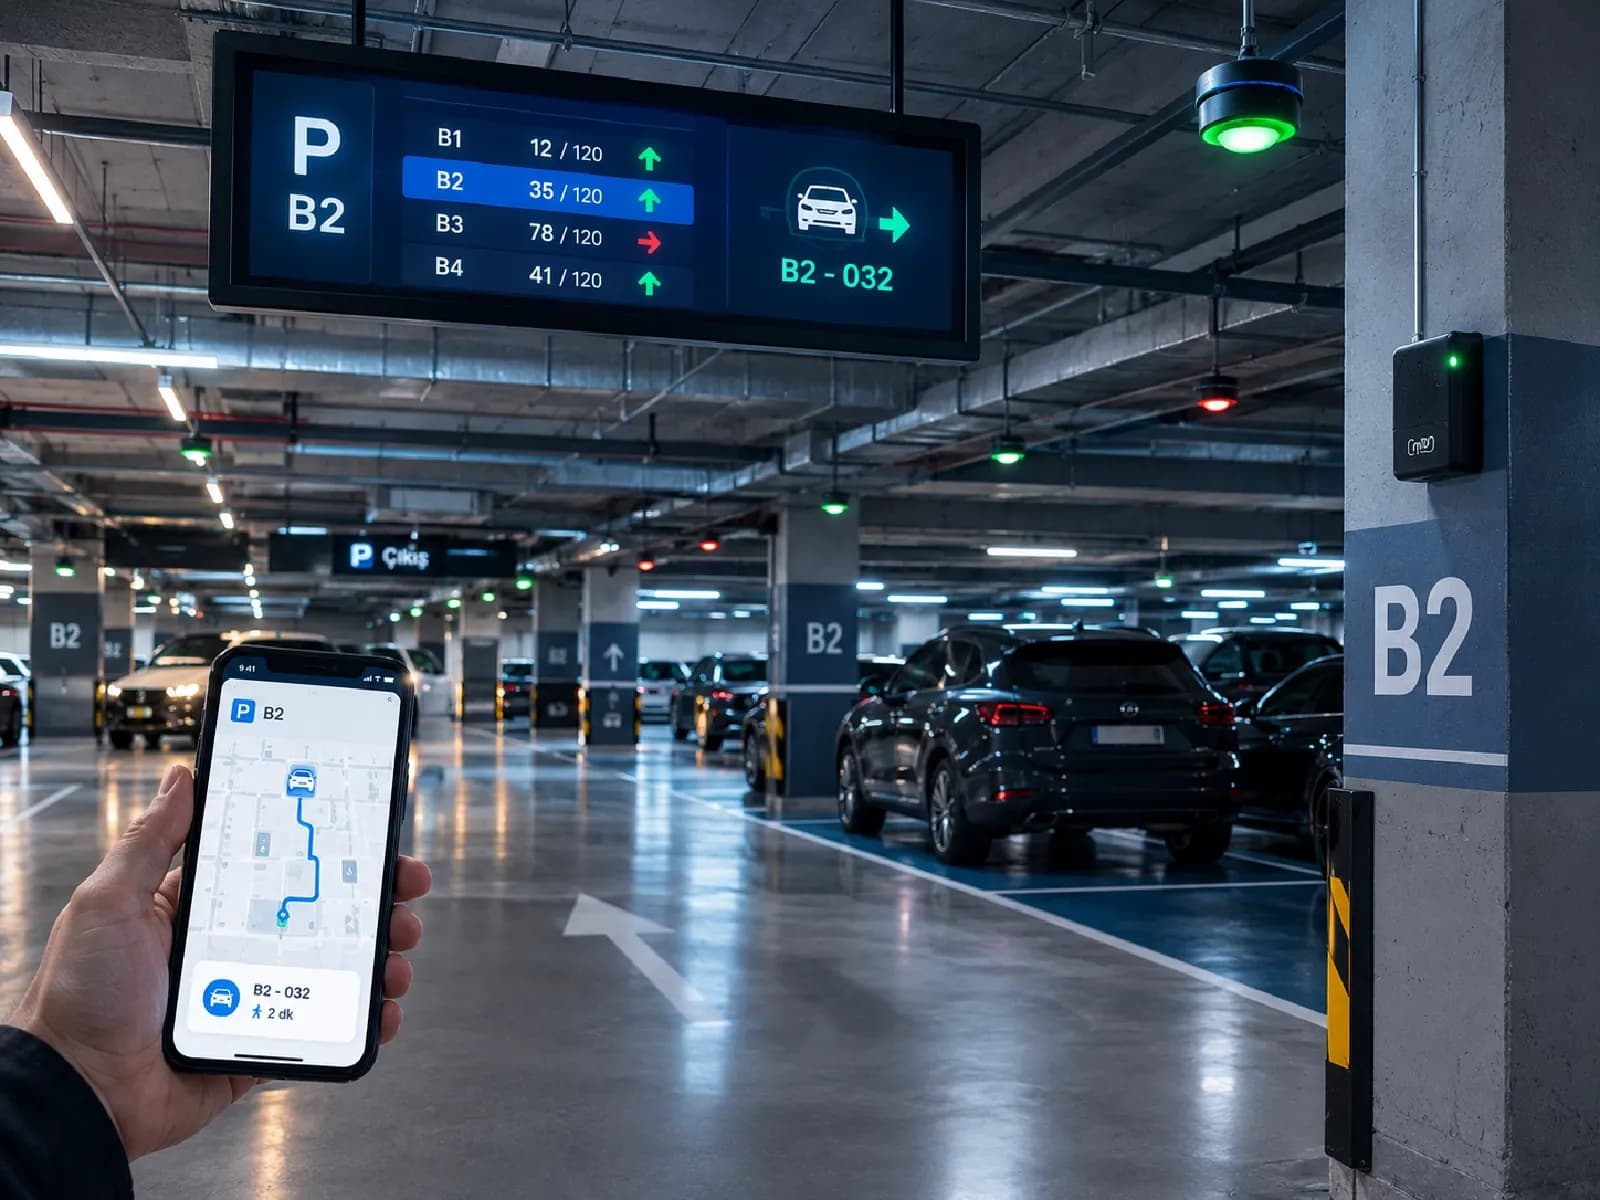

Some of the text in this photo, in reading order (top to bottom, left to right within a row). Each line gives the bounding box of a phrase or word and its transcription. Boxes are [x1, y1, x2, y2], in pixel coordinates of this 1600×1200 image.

[294, 115, 341, 176] P
[437, 127, 603, 162] B1 12 / 120
[436, 170, 603, 205] B2 35 / 120
[288, 193, 345, 234] B2
[435, 213, 603, 247] B3 78 / 120
[435, 256, 603, 289] B4 41 / 120
[781, 257, 816, 285] B2
[842, 263, 894, 292] 032
[350, 543, 372, 567] P
[50, 622, 81, 649] B2
[806, 621, 843, 654] B2
[1374, 576, 1473, 697] B2
[237, 703, 284, 721] P B2
[253, 984, 272, 998] B2
[284, 986, 311, 1000] 032
[267, 1007, 294, 1021] 2 dk
